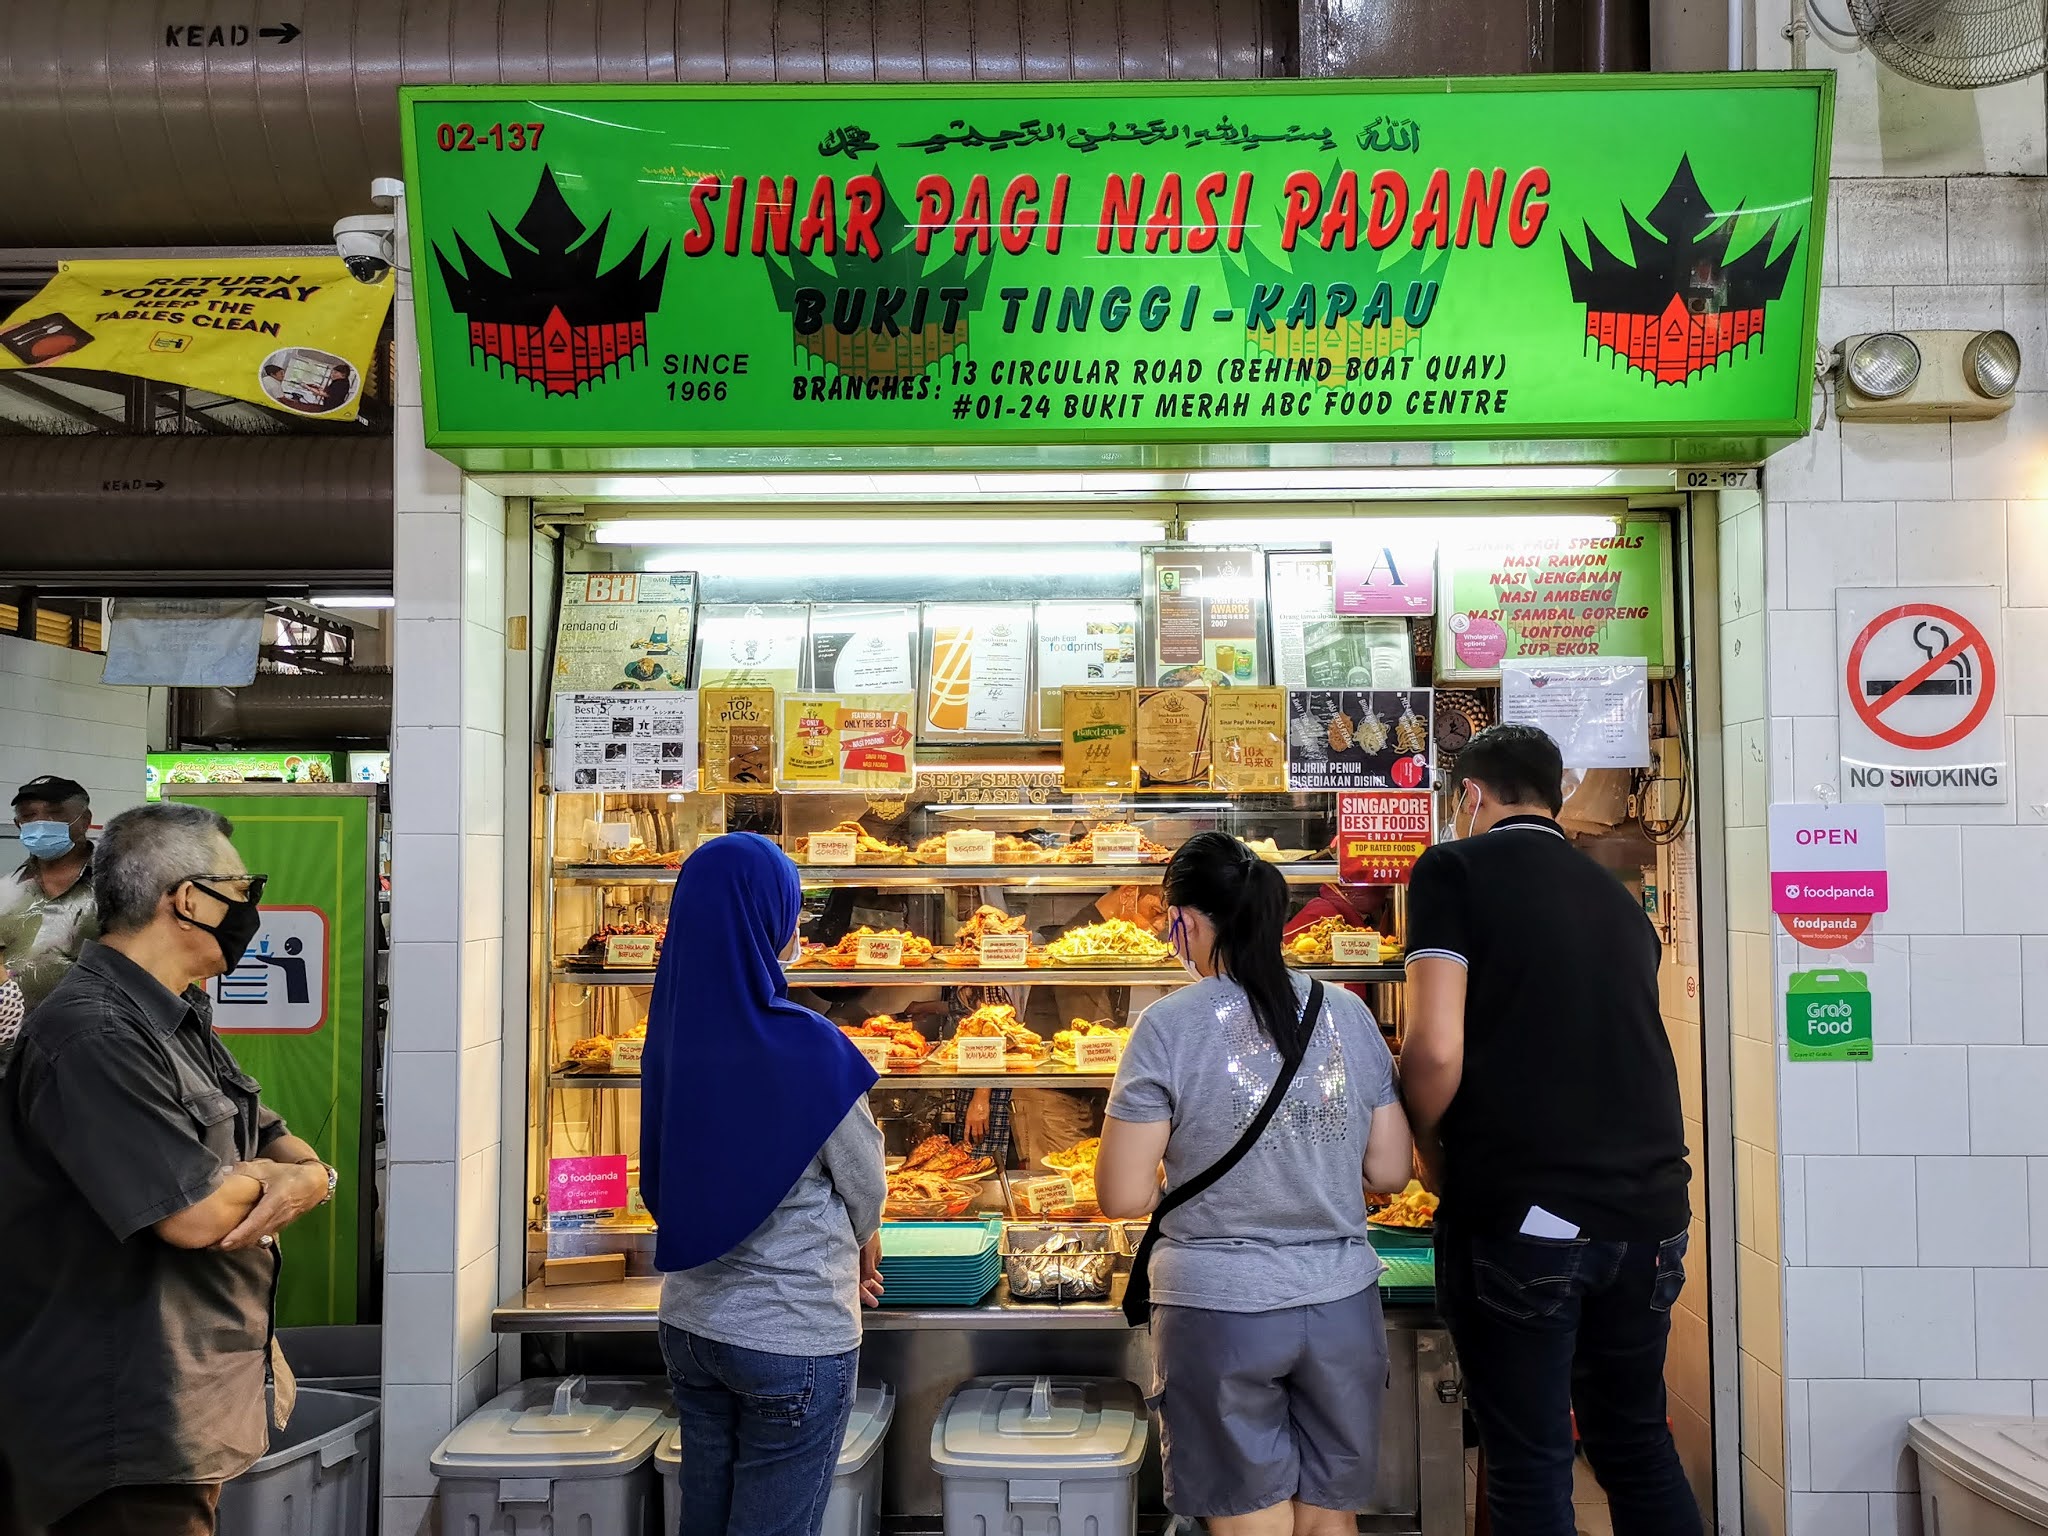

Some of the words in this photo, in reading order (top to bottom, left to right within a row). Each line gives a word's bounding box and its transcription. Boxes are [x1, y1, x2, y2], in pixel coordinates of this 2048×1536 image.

[166, 25, 249, 47] KEAD
[436, 122, 546, 152] 02-137
[683, 174, 886, 262] SINAR
[915, 173, 1072, 257] PAGI
[1096, 171, 1255, 254] NASI
[1281, 167, 1551, 252] PADANG
[145, 275, 301, 287] RETURN
[100, 287, 212, 299] YOUR
[221, 286, 321, 302] TRAY
[133, 300, 199, 310] KEEP
[207, 300, 255, 315] THE
[794, 286, 970, 338] BUKIT
[95, 310, 185, 324] TABLES
[192, 314, 282, 338] CLEAN
[663, 354, 750, 376] SINCE
[952, 361, 978, 386] 13
[991, 358, 1119, 386] CIRCULAR
[1133, 358, 1202, 384] ROAD
[1217, 357, 1332, 384] (BEHIND
[1346, 356, 1413, 381] BOAT
[1426, 354, 1507, 381] QUAY)
[667, 381, 728, 402] 1966
[793, 375, 941, 402] BRANCHES:
[952, 393, 1050, 420] #01-24
[1064, 393, 1144, 419] BUKIT
[1155, 392, 1250, 418] MERAH
[1262, 391, 1312, 417] ABC
[1325, 390, 1392, 416] FOOD
[1406, 389, 1510, 415] CENTRE
[1568, 536, 1644, 550] SPECIALS
[1360, 547, 1409, 587] A
[1504, 555, 1540, 568] NASI
[1548, 554, 1607, 567] RAWON
[1490, 573, 1527, 585] NASI
[1534, 571, 1622, 584] JENGANAN
[588, 577, 632, 601] BH
[1500, 591, 1537, 603] NASI
[1543, 589, 1613, 602] AMBENG
[1210, 604, 1249, 614] AWARDS
[1468, 609, 1504, 621] NASI
[1512, 608, 1576, 621] SAMBAL
[1582, 606, 1649, 620] GORENG
[562, 621, 606, 632] rendang
[609, 620, 618, 631] di
[1521, 625, 1595, 639] LONTONG
[1050, 642, 1103, 653] foodprints
[1517, 643, 1549, 656] SUP
[1556, 642, 1599, 656] EKOR
[574, 705, 595, 714] Best
[600, 703, 607, 714] 5
[727, 700, 752, 711] TOP
[721, 710, 759, 722] PICKS!
[806, 719, 820, 727] ONLY
[844, 719, 860, 728] ONLY
[863, 719, 873, 728] THE
[1077, 728, 1100, 736] Rated
[1244, 747, 1264, 757] 10大
[1291, 762, 1327, 774] BIJIRIN
[1329, 762, 1362, 773] PENUH
[920, 773, 975, 788] SELF
[981, 773, 1064, 788] SERVICE
[1851, 767, 1884, 787] NO
[1890, 767, 1998, 787] SMOKING
[937, 788, 1019, 803] PLEASE
[1342, 798, 1428, 814] SINGAPORE
[1344, 816, 1377, 829] BEST
[1382, 816, 1425, 829] FOODS
[1796, 829, 1858, 845] OPEN
[816, 842, 848, 850] TEMPEH
[1373, 869, 1400, 878] 2017
[1803, 885, 1874, 900] foodpanda
[1793, 917, 1857, 931] foodpanda
[1807, 999, 1852, 1018] Grab
[1807, 1017, 1852, 1035] Food
[570, 1172, 618, 1183] foodpanda
